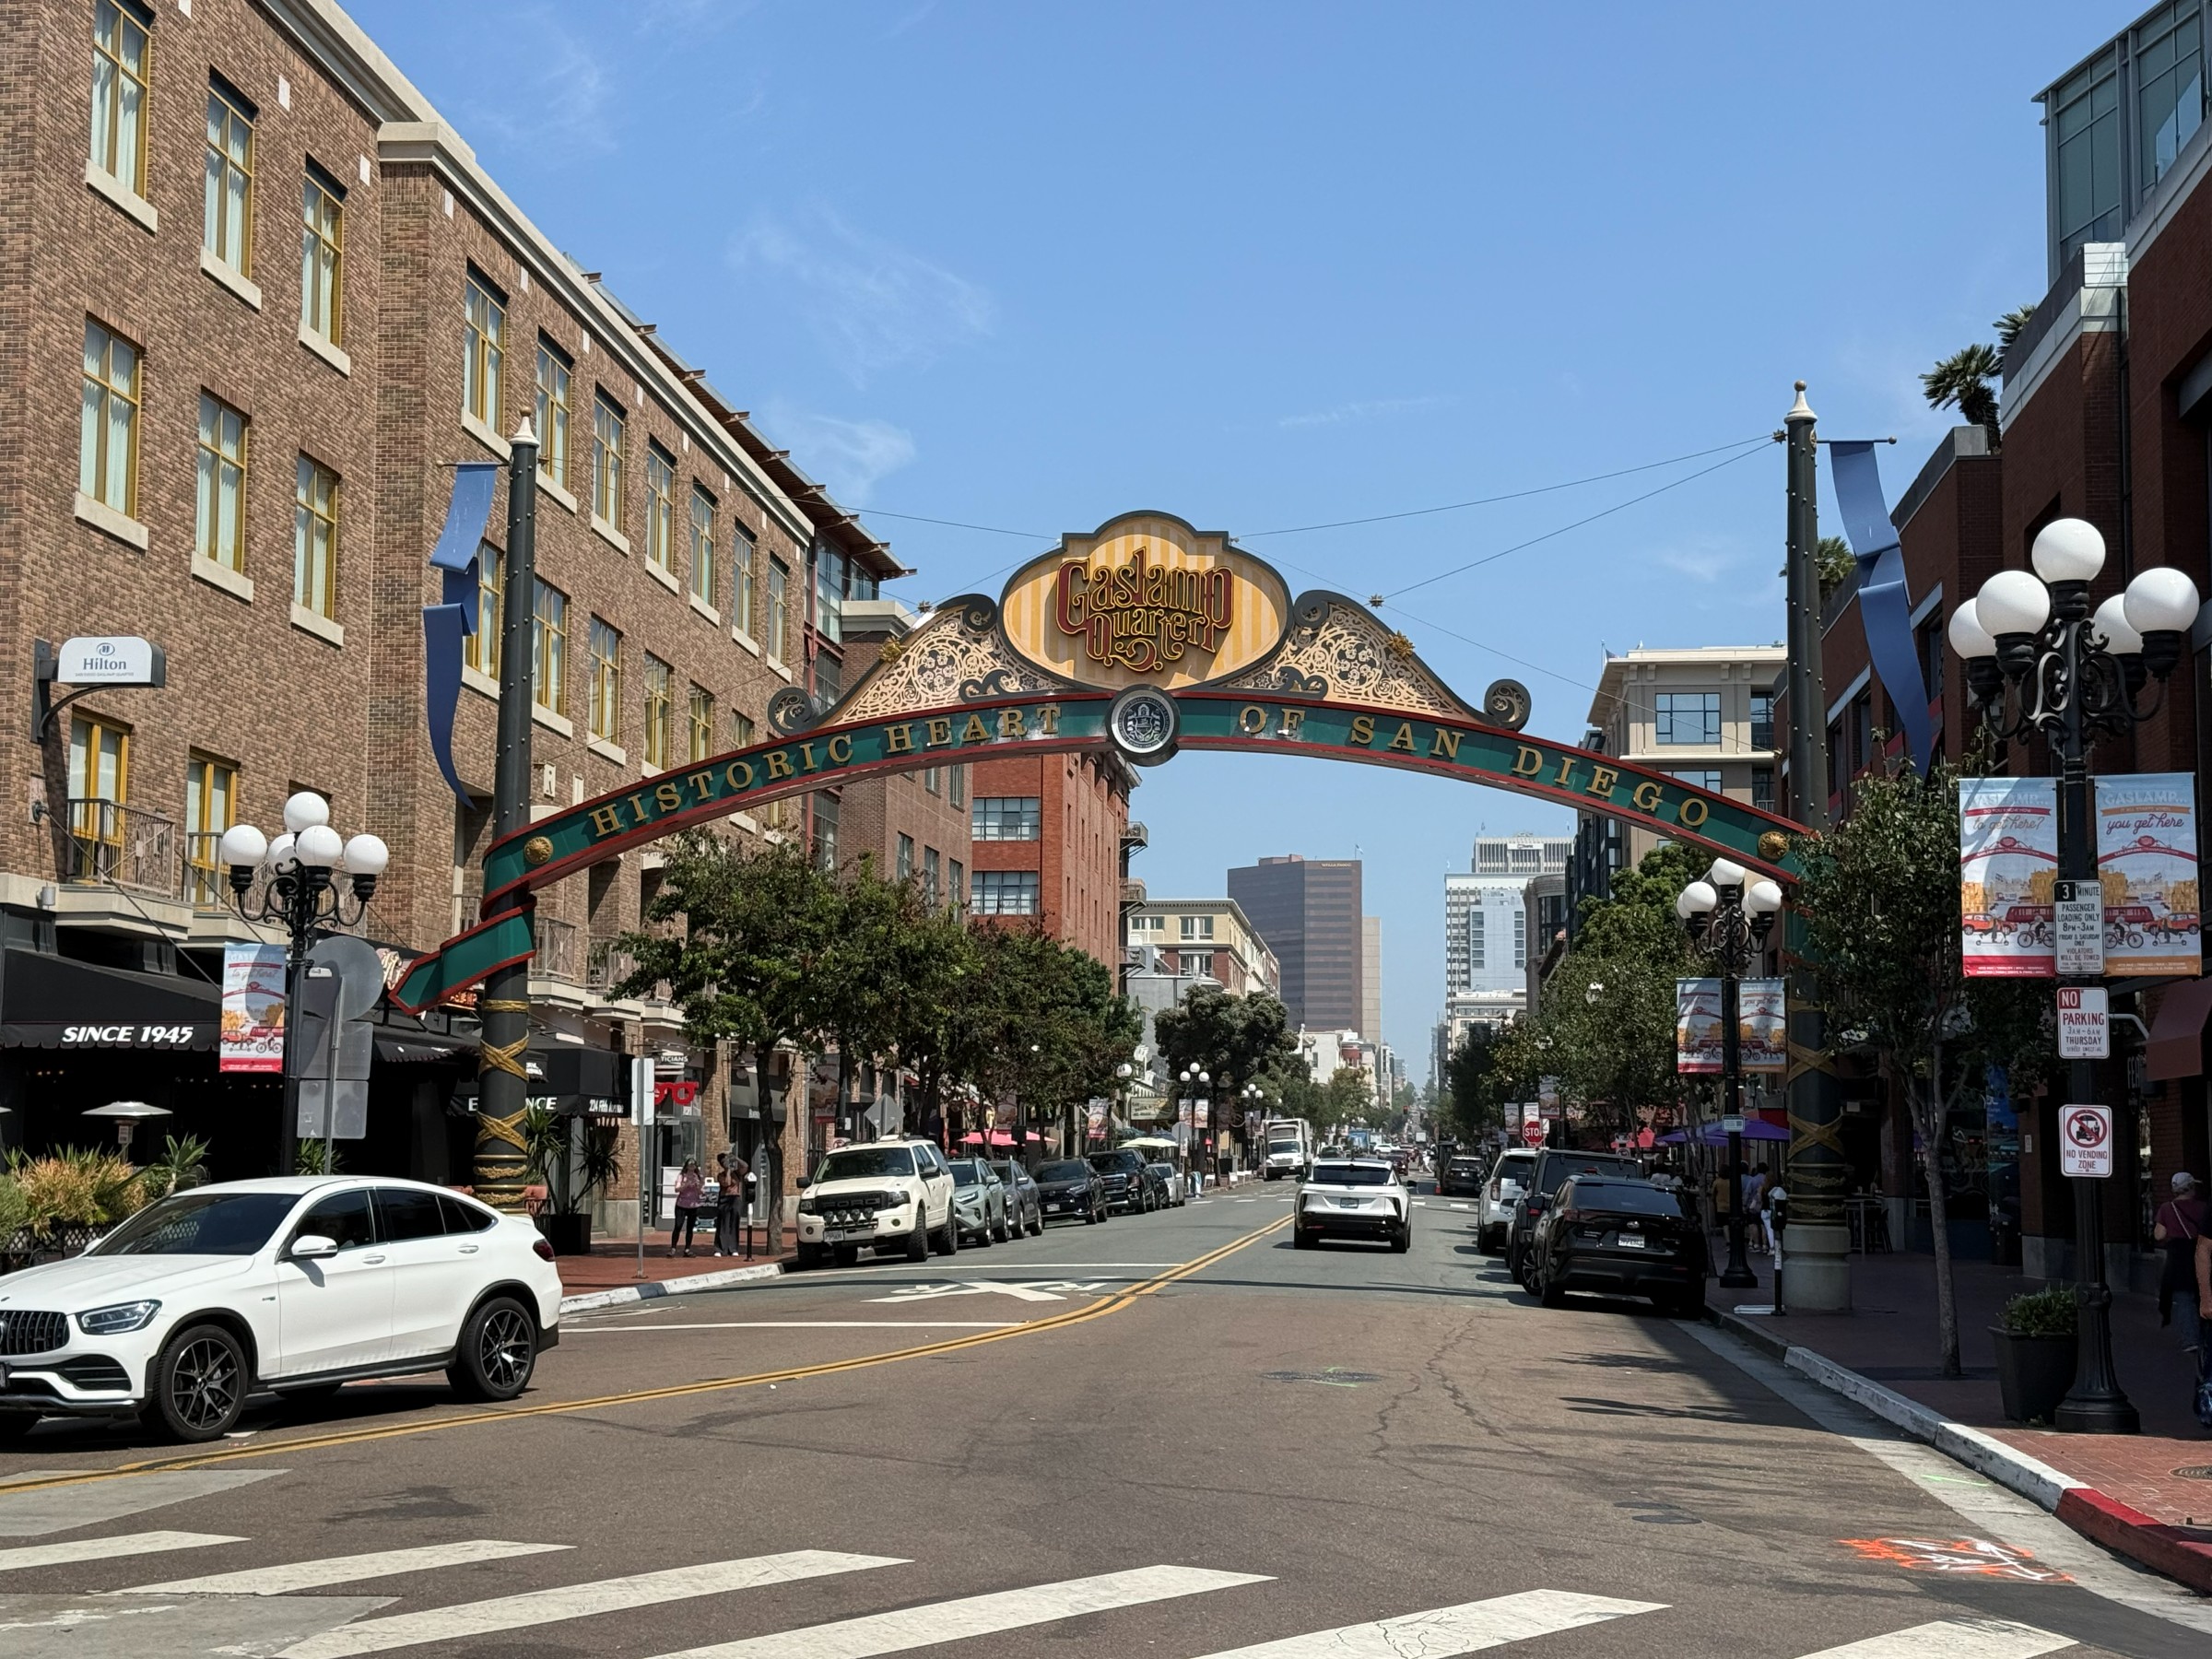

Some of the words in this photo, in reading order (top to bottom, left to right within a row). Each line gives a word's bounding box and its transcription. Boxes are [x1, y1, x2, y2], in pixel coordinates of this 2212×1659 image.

[1056, 546, 1234, 653] Gaslamp
[1086, 607, 1209, 672] Quarter
[83, 657, 127, 670] Hilton
[588, 735, 854, 838] HISTORIC
[883, 706, 1062, 754] HEART
[1240, 705, 1306, 735] OF
[1350, 716, 1465, 759] SAN
[1512, 745, 1709, 828] DIEGO
[1973, 816, 1985, 830] to
[1988, 815, 2007, 836] get
[2007, 814, 2045, 830] here?
[2106, 819, 2131, 835] you
[2133, 813, 2154, 835] get
[2154, 812, 2184, 828] here
[2062, 884, 2070, 900] 3
[2077, 887, 2100, 897] MINUTE
[2062, 903, 2095, 912] PASSENGER
[2057, 913, 2082, 923] LOADING
[2084, 913, 2100, 922] ONLY
[2062, 991, 2078, 1007] NO
[2063, 1013, 2105, 1026] PARKING
[62, 1026, 135, 1042] SINCE
[140, 1026, 194, 1043] 1945
[2065, 1036, 2102, 1045] THURSDAY
[468, 1097, 557, 1112] ENCE
[2066, 1149, 2077, 1159] NO
[2078, 1150, 2108, 1159] VENDING
[2077, 1160, 2097, 1169] ZONE
[823, 1198, 880, 1209] FORD
